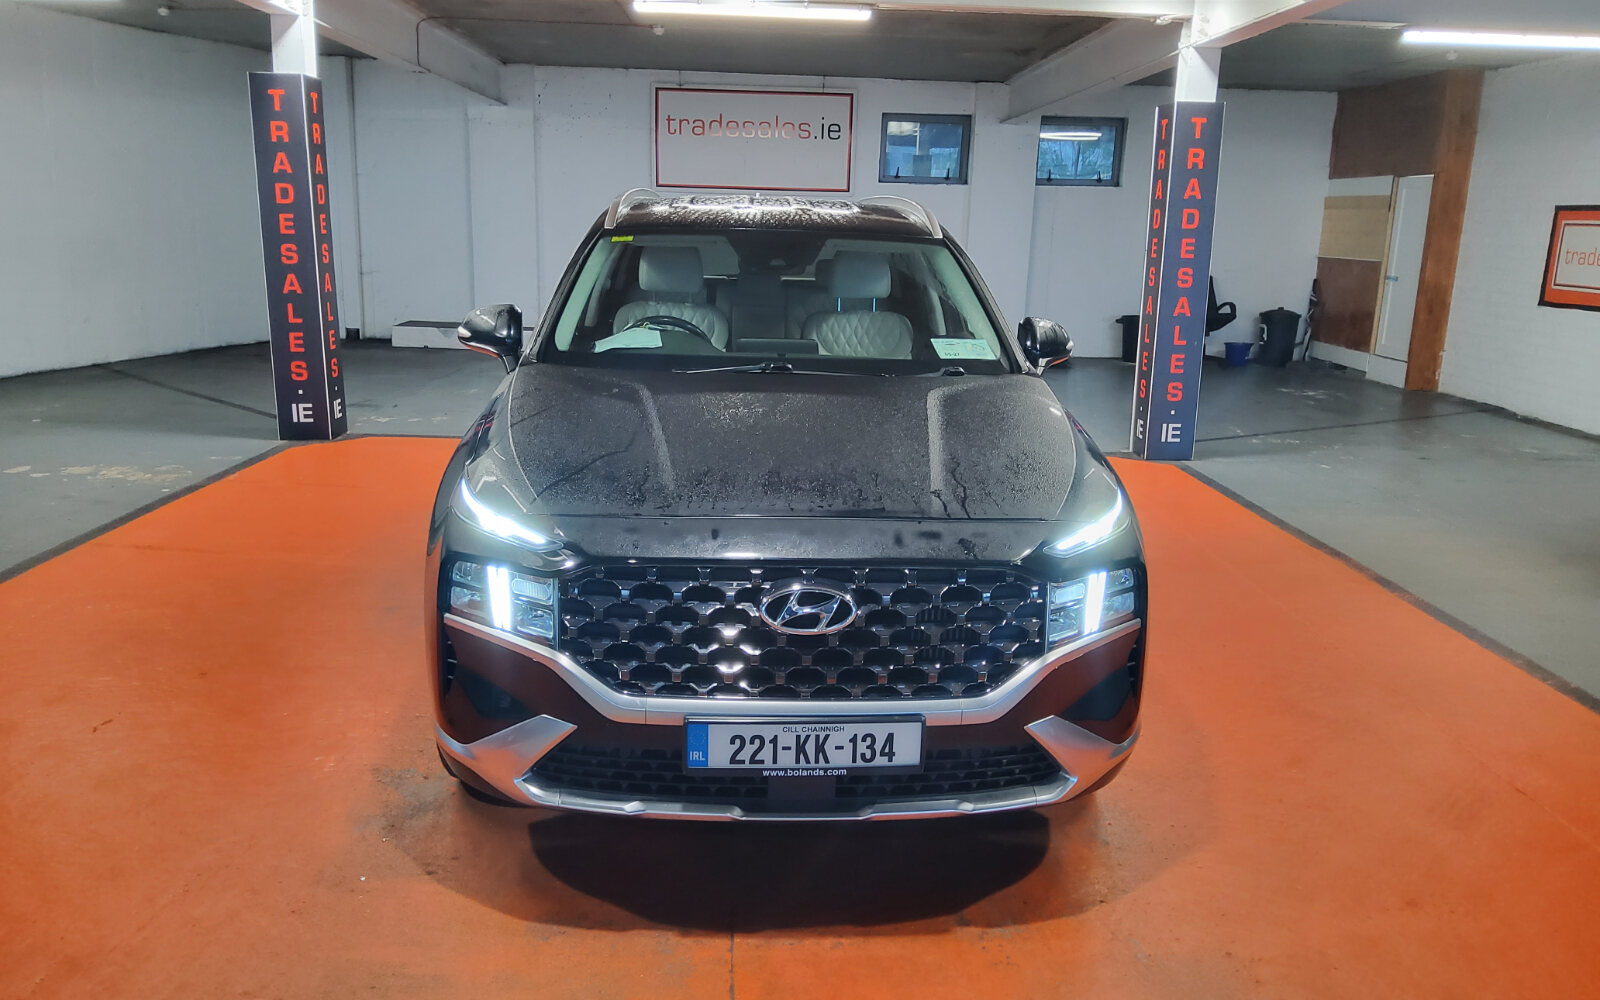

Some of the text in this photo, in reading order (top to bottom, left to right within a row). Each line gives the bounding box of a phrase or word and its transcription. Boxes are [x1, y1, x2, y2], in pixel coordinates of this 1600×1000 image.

[665, 113, 841, 141] tradesales.ie
[801, 725, 845, 733] CHAINNIGH
[729, 733, 896, 765] 221-KK-134
[689, 751, 706, 761] IRL
[762, 768, 847, 777] www.bolands.com
